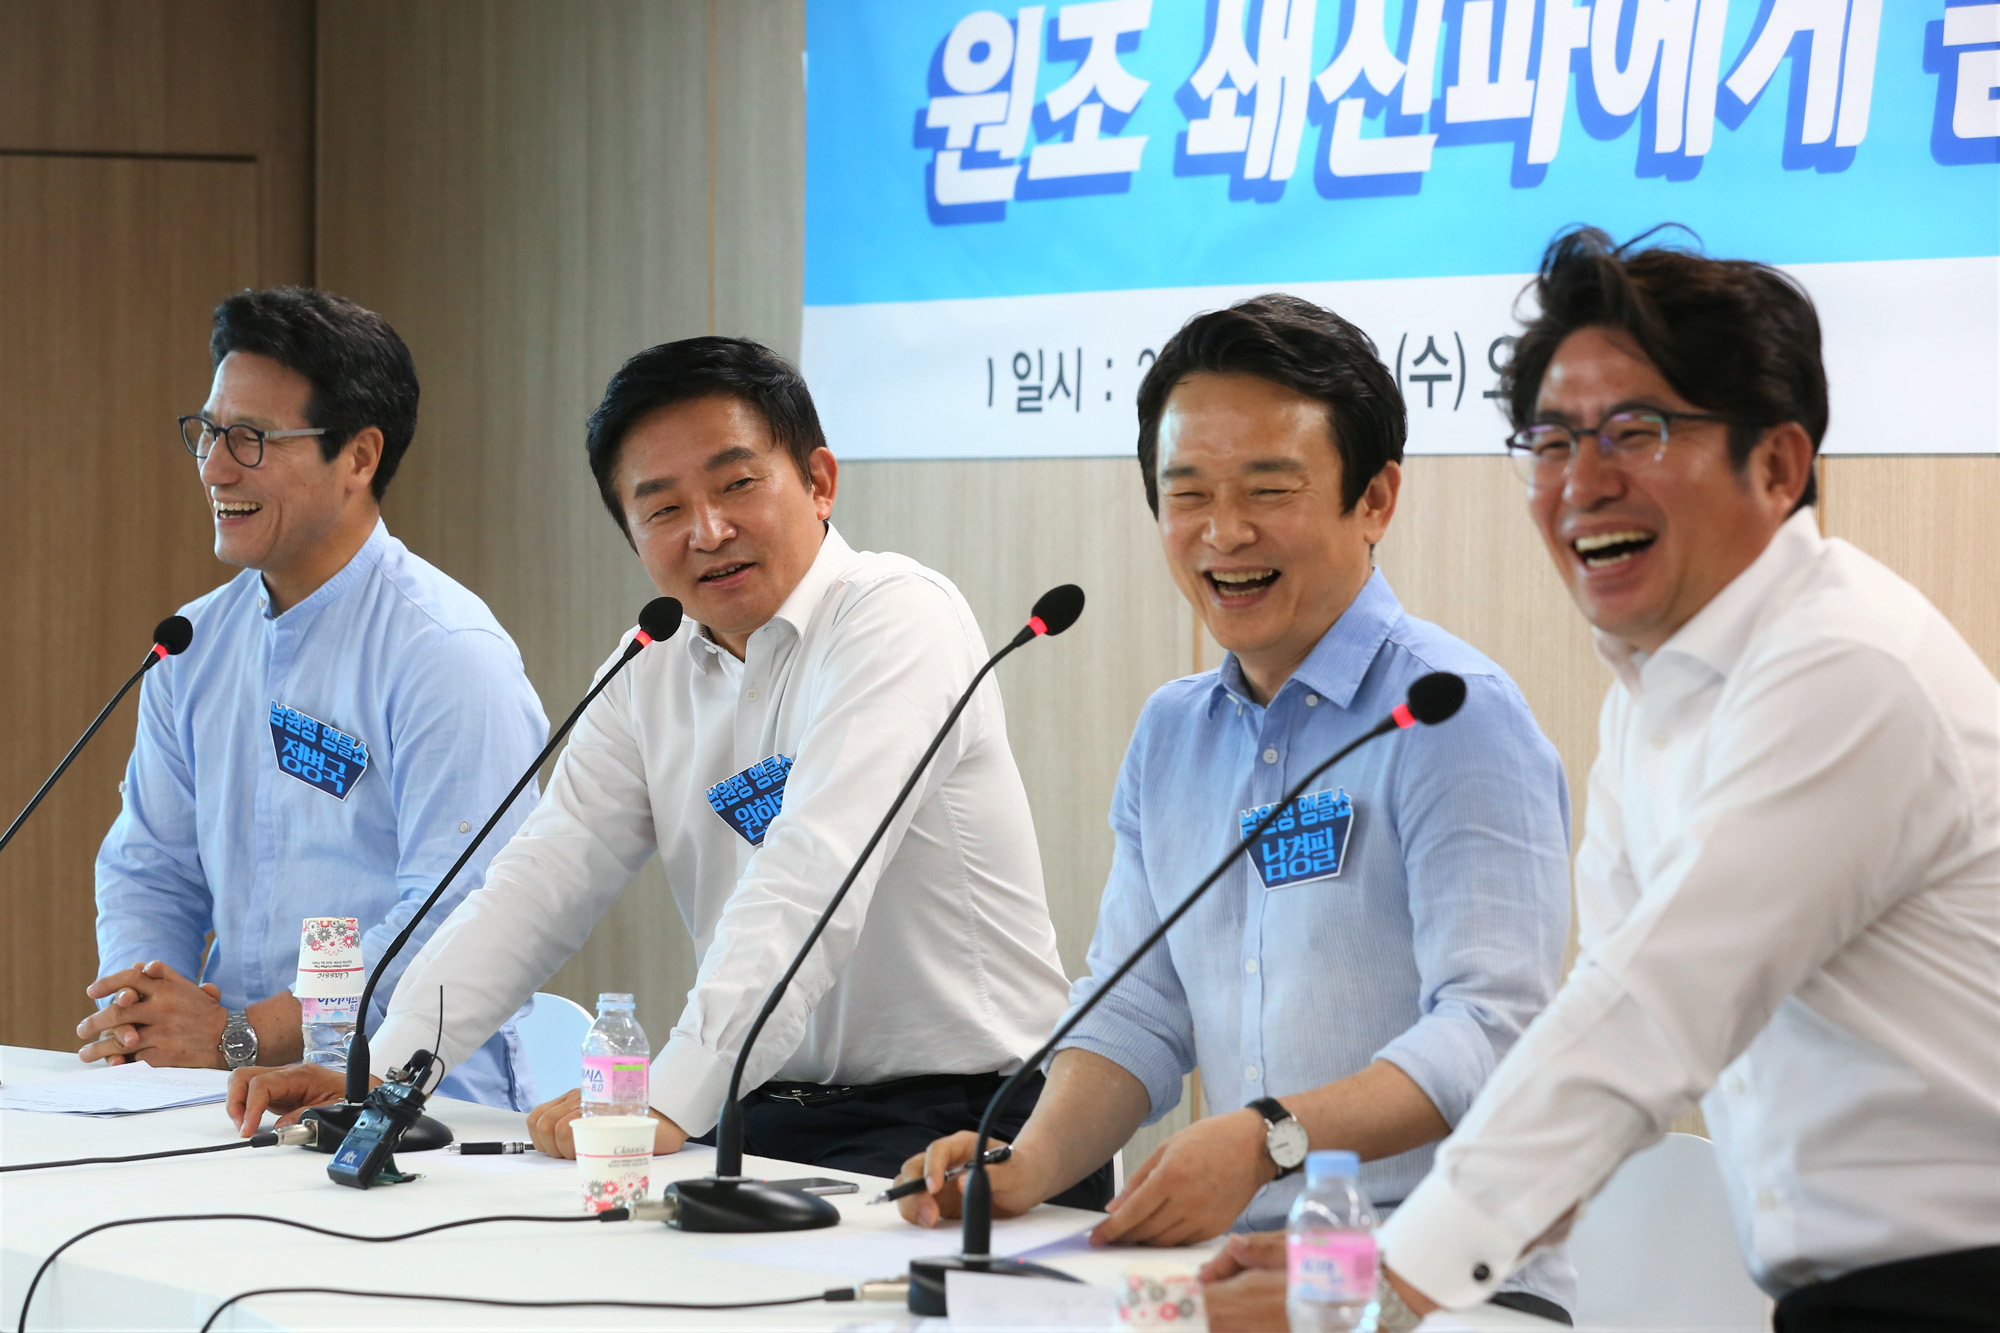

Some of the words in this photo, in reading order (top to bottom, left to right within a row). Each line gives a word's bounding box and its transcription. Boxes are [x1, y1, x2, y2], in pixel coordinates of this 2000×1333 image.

[926, 0, 1153, 206] 원조
[1186, 0, 1883, 181] 쇄신파에게
[1013, 347, 1081, 412] 일시
[270, 701, 319, 743] 남원정
[282, 737, 346, 793] 정병국
[706, 773, 754, 812] 남원정
[1262, 827, 1337, 882] 남경필
[317, 972, 349, 981] Classic
